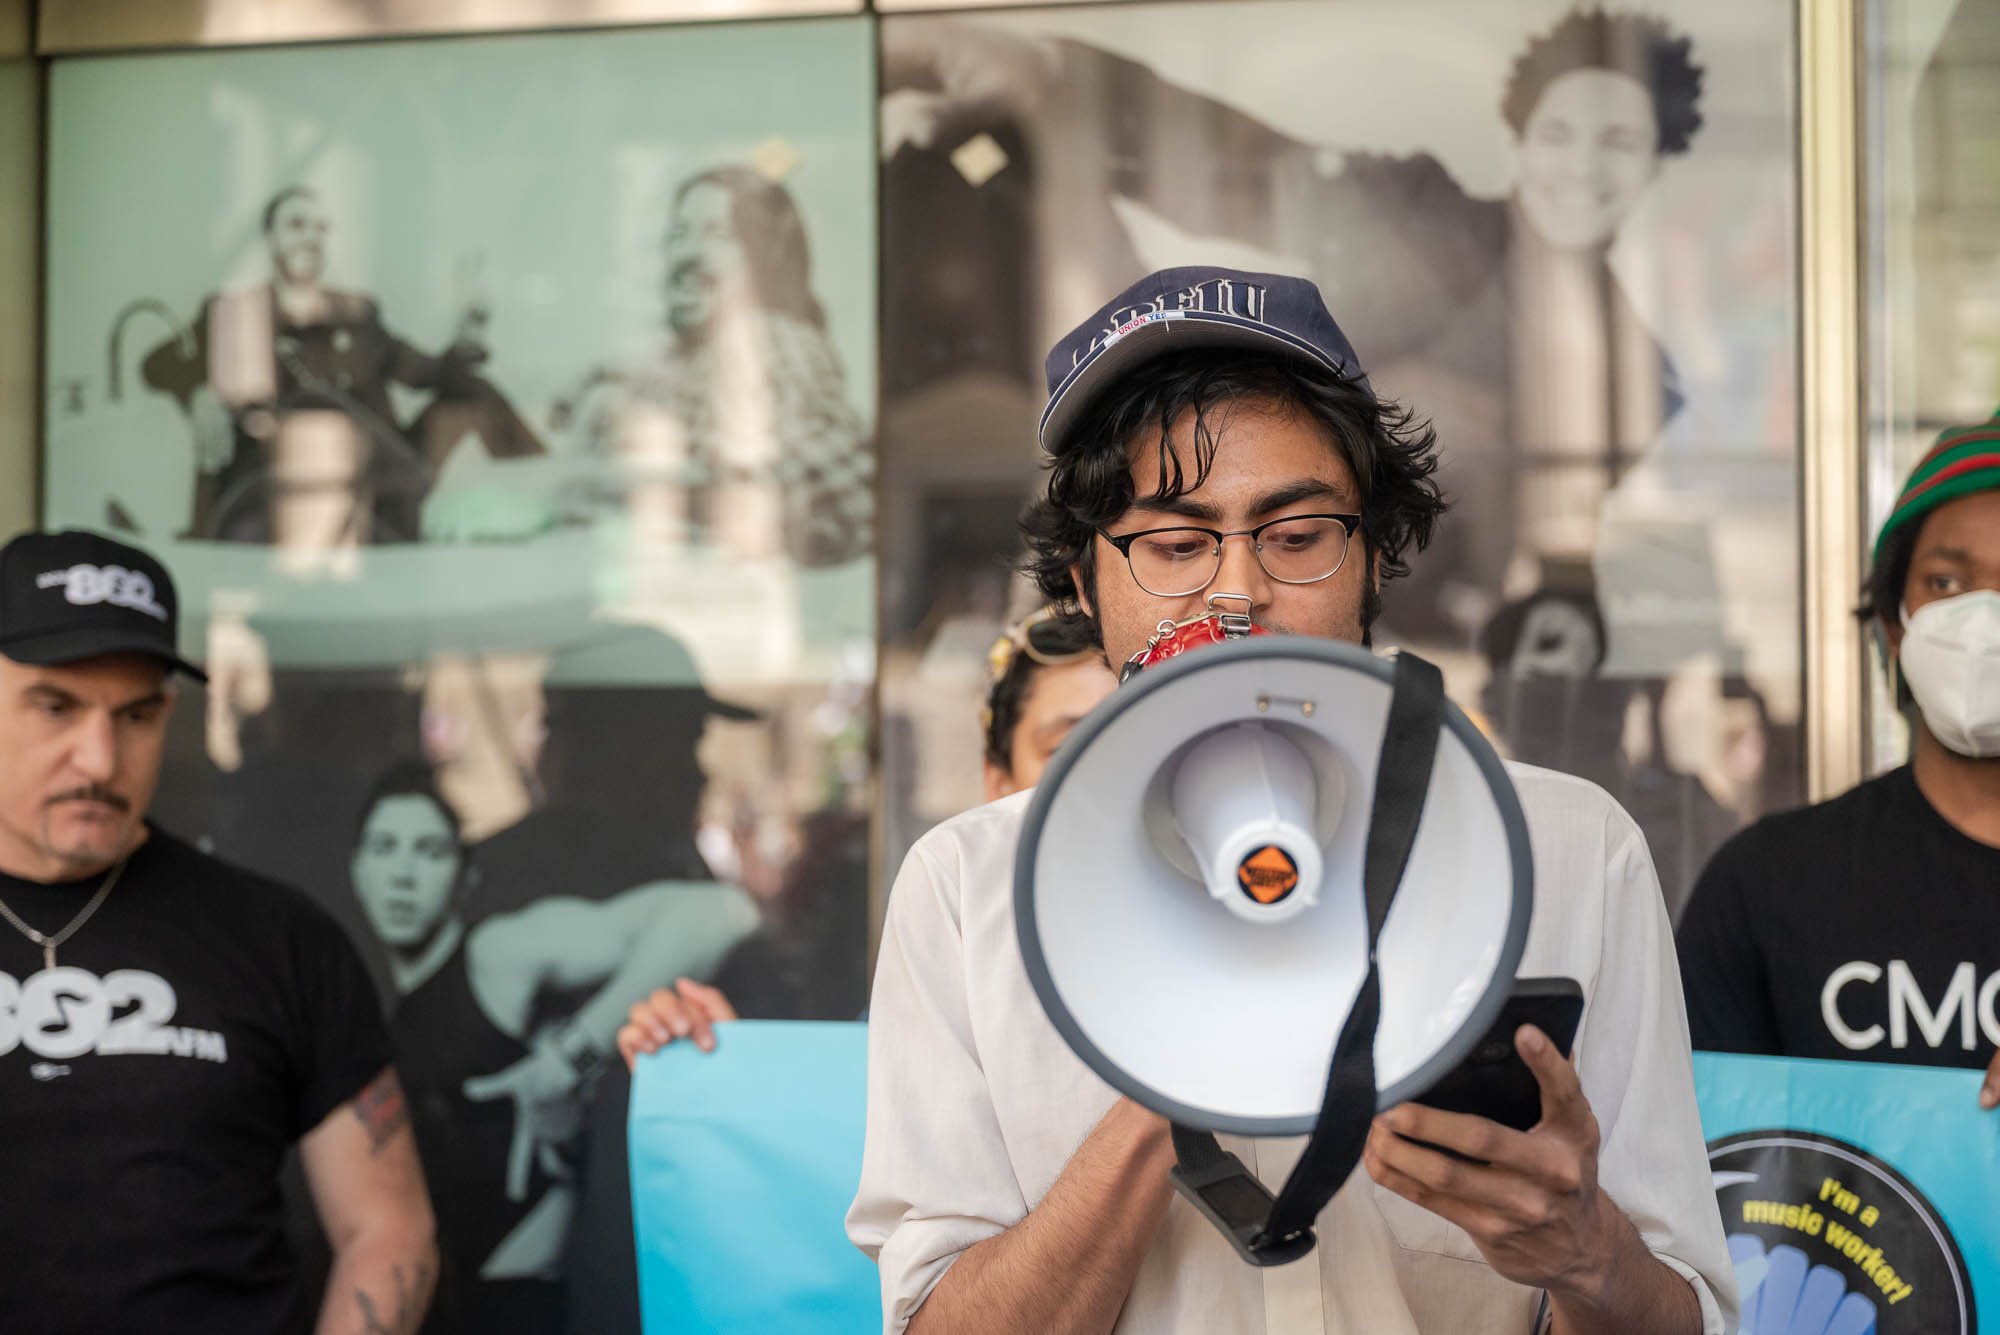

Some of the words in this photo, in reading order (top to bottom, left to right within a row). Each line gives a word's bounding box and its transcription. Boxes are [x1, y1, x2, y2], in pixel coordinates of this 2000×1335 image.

[1118, 316, 1147, 335] UNION
[0, 965, 177, 1059] 02
[1742, 1199, 1825, 1236] music
[1819, 1176, 1861, 1215] I'm
[1859, 1204, 1880, 1228] a
